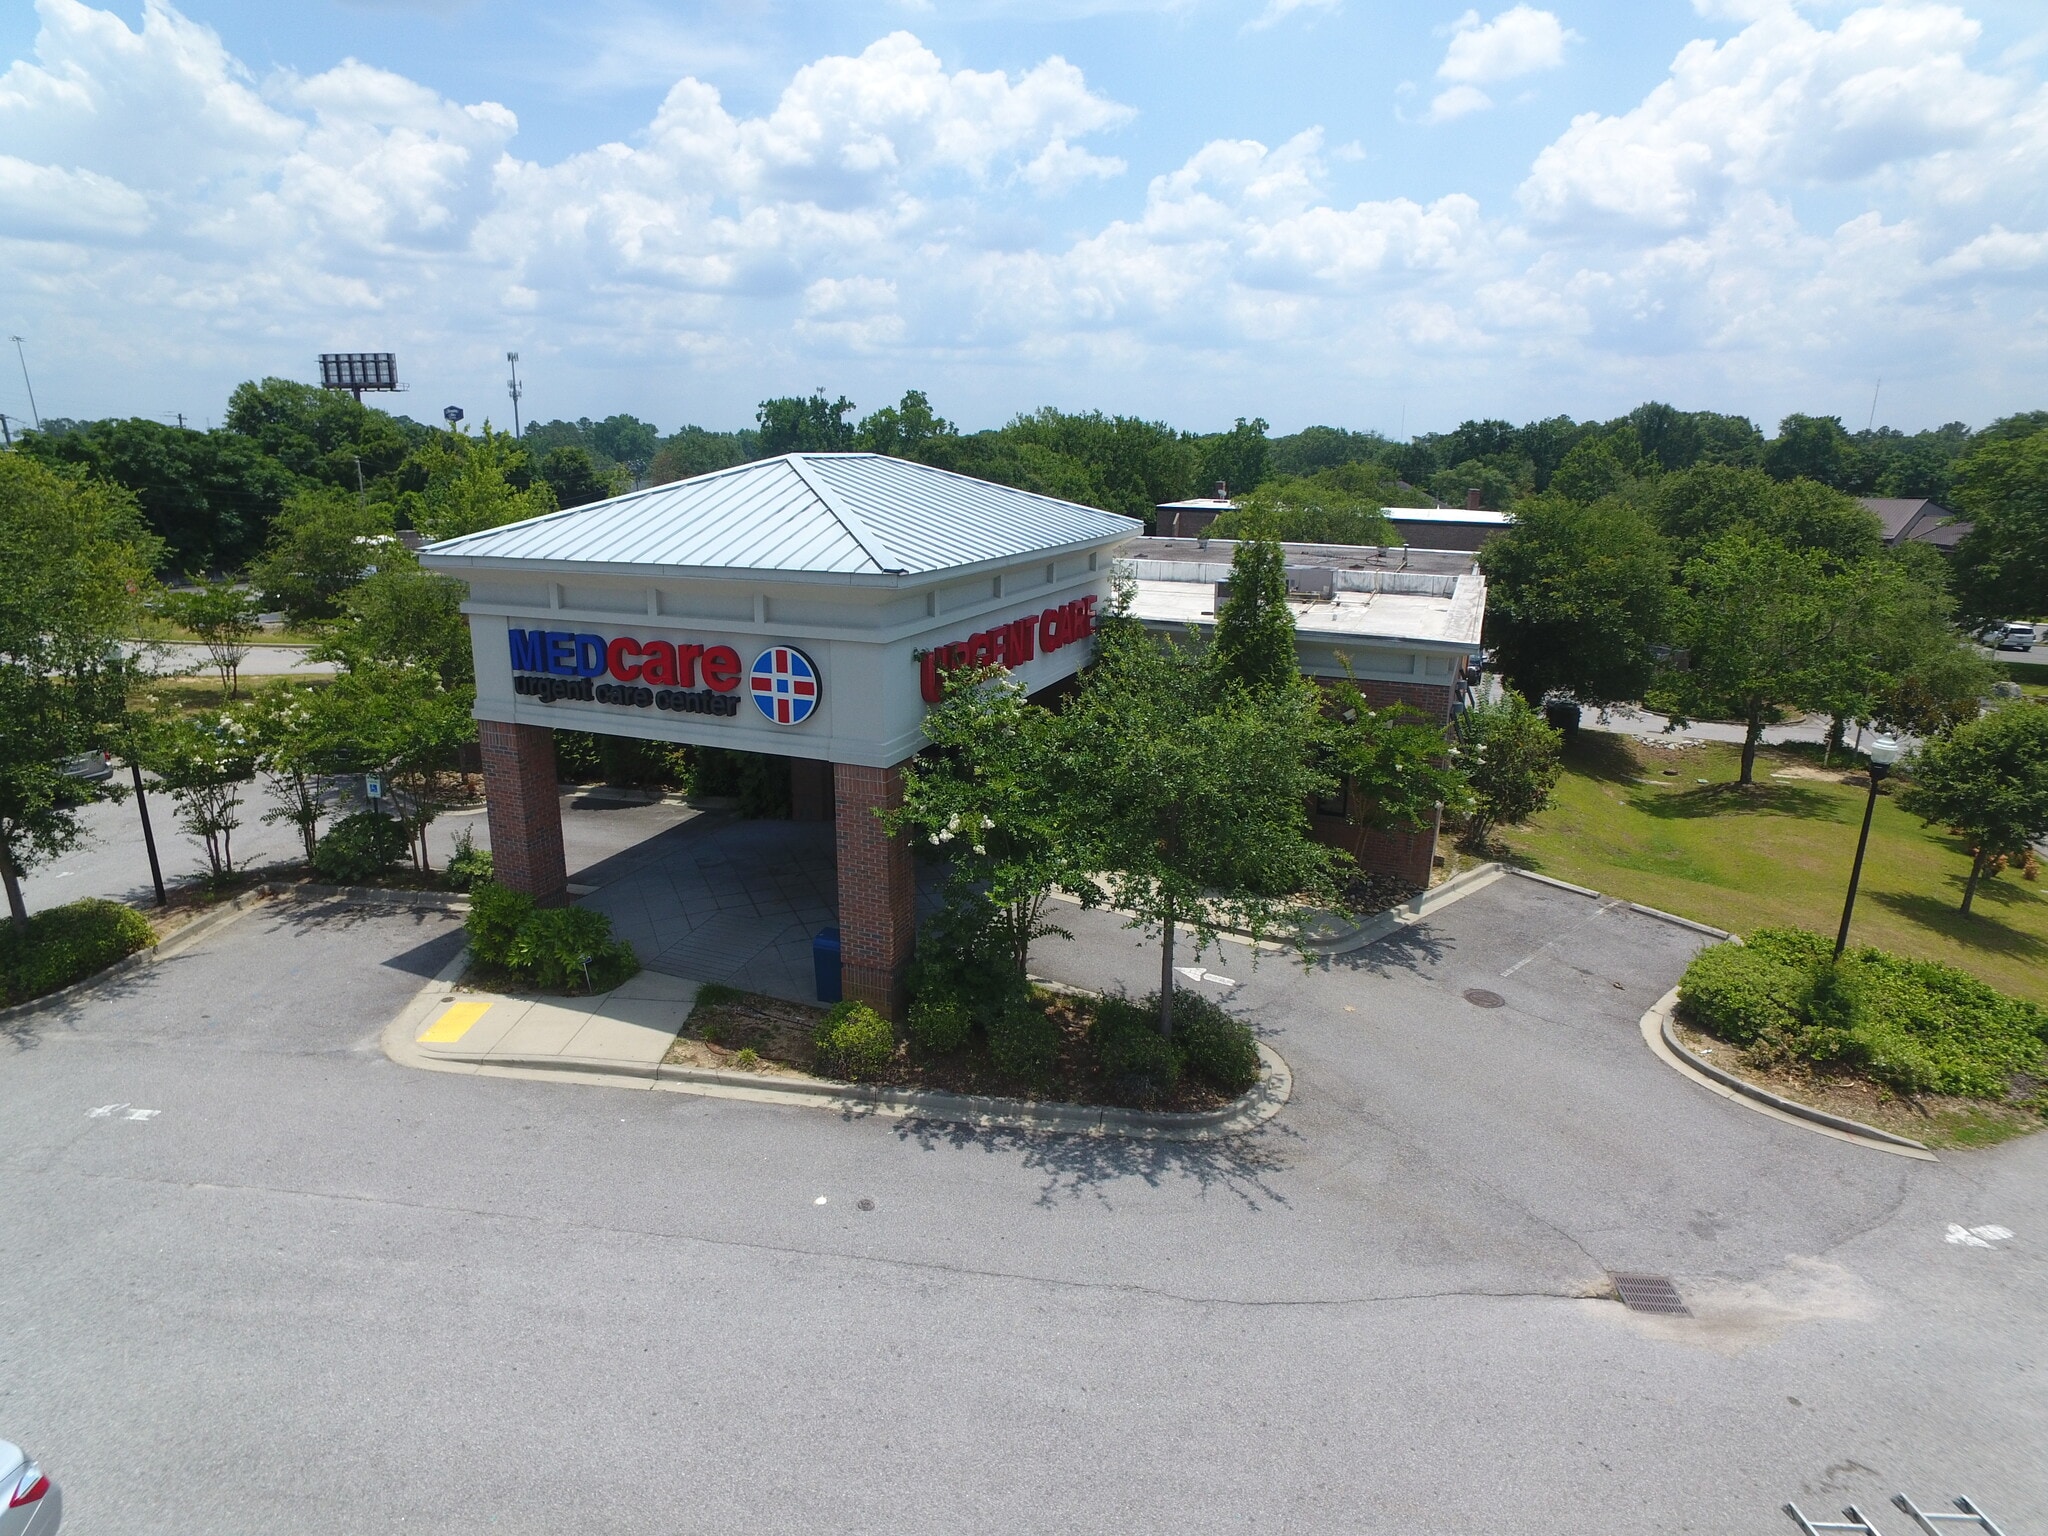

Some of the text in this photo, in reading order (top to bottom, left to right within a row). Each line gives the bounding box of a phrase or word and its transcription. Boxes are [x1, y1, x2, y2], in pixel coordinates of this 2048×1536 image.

[1039, 595, 1097, 653] CARE
[509, 629, 742, 692] MEDcare
[514, 676, 741, 717] urgent care center
